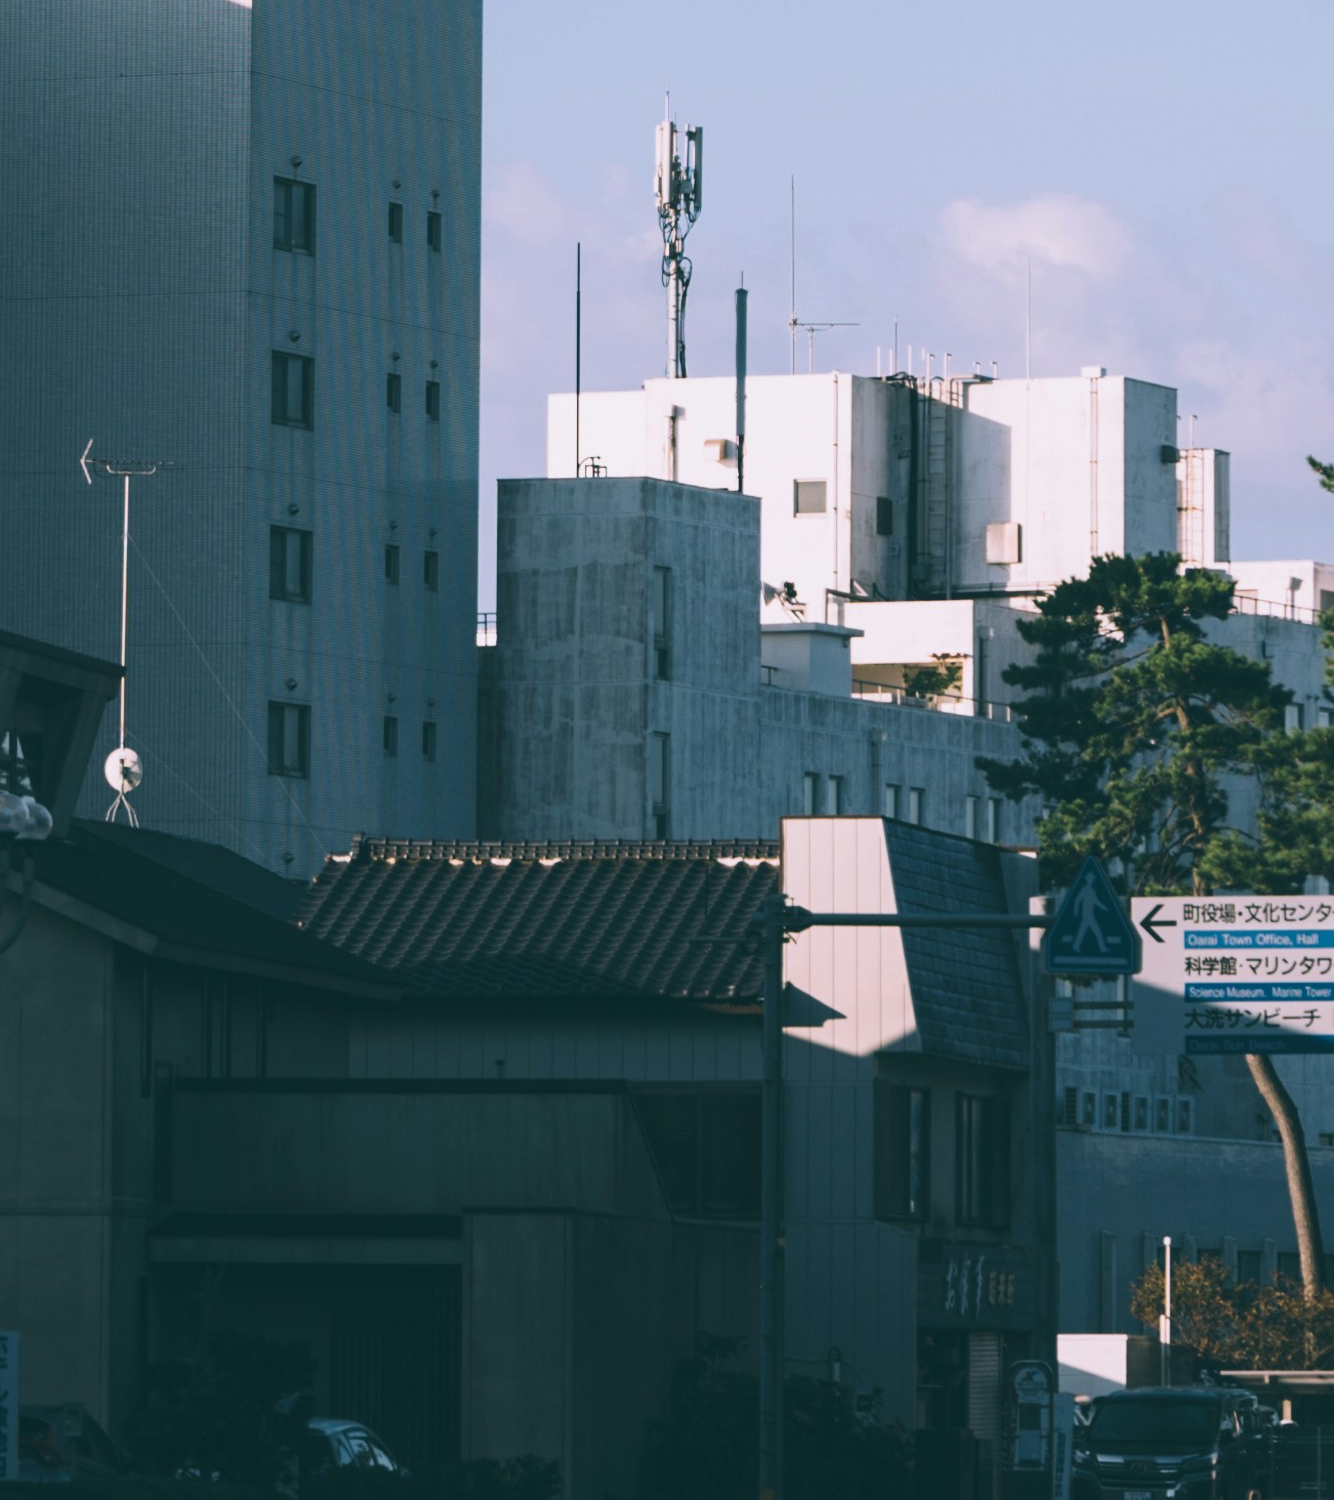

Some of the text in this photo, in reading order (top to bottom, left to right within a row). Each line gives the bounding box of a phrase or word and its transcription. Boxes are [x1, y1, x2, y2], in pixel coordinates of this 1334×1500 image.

[1188, 933, 1320, 947] Oarai Town Office, Hall
[1189, 986, 1225, 998] Science
[1272, 986, 1303, 998] Marine
[1305, 986, 1332, 998] Tower
[1184, 1008, 1322, 1029] 大洗サンビーチ
[1189, 1040, 1219, 1051] Oarai
[1224, 1040, 1245, 1051] Sun
